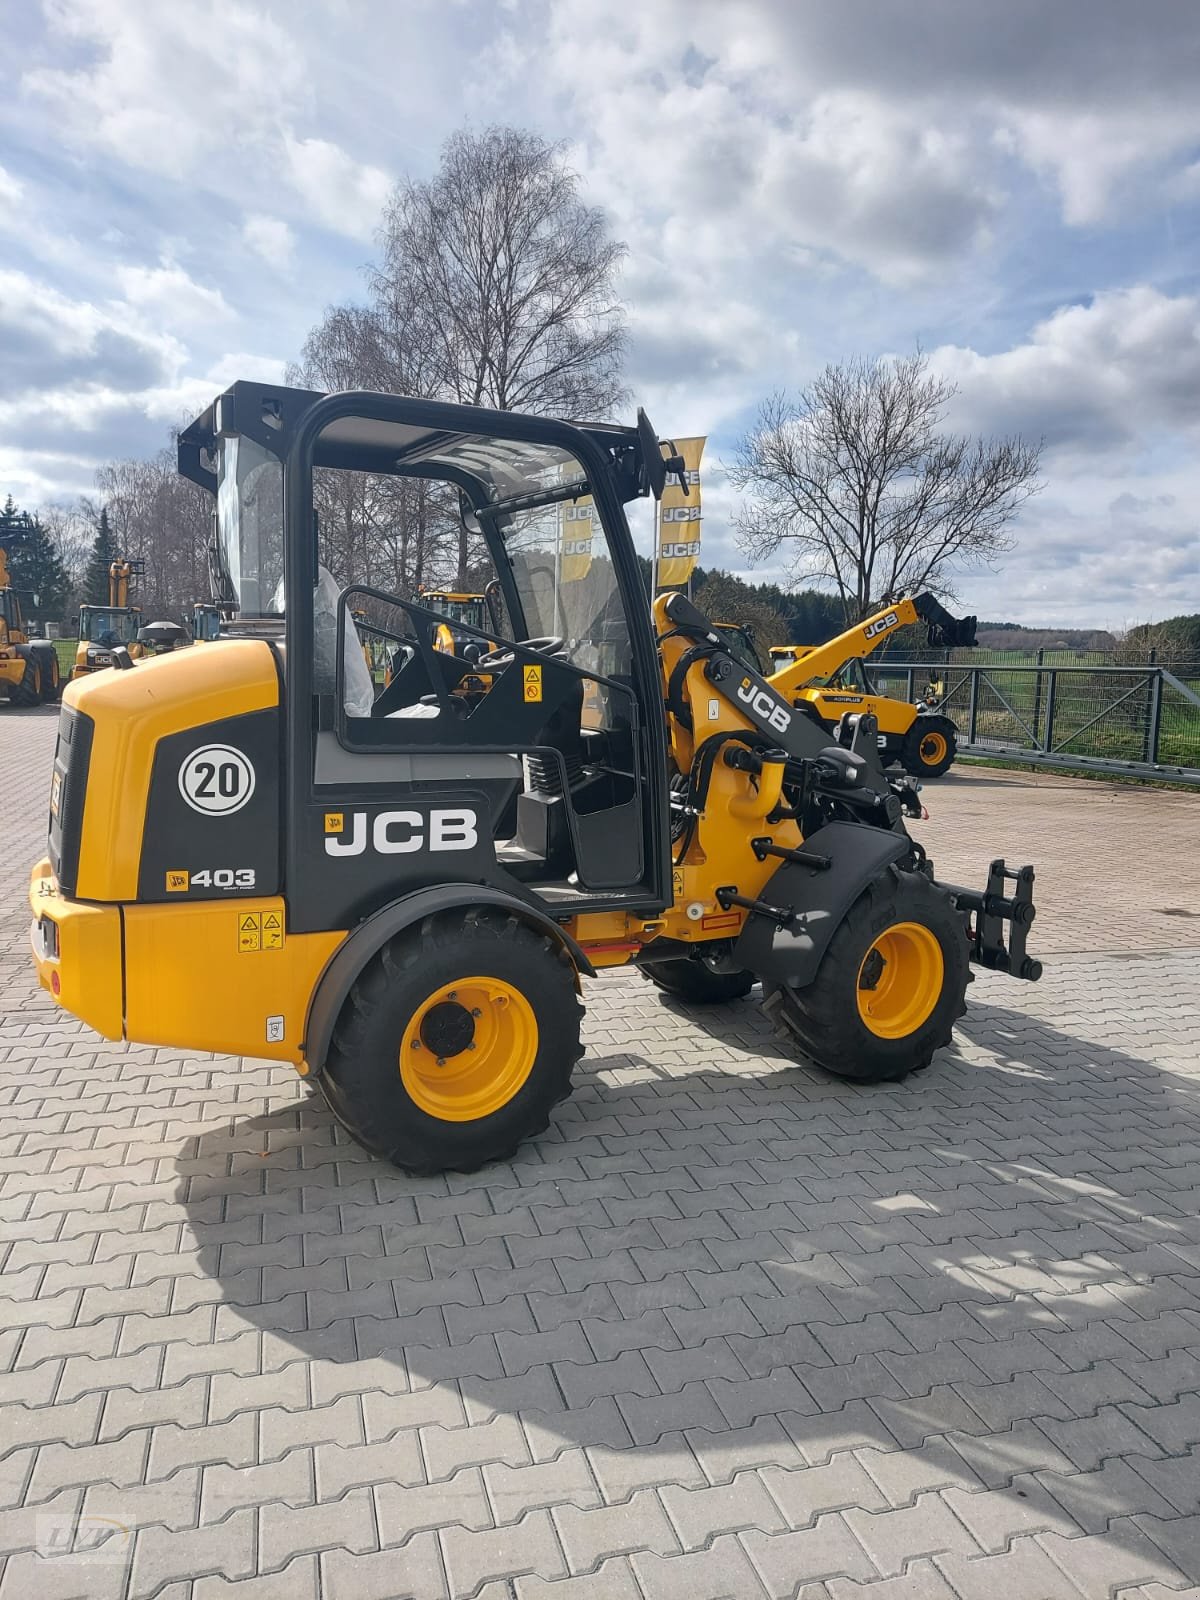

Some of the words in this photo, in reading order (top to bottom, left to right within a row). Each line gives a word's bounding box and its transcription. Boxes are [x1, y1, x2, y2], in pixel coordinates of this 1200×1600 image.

[663, 506, 701, 522] JCB
[661, 543, 700, 558] JCB
[864, 612, 898, 639] JCB
[737, 683, 792, 733] JCB
[194, 762, 240, 798] 20
[324, 809, 478, 857] JCB
[190, 869, 256, 887] 403
